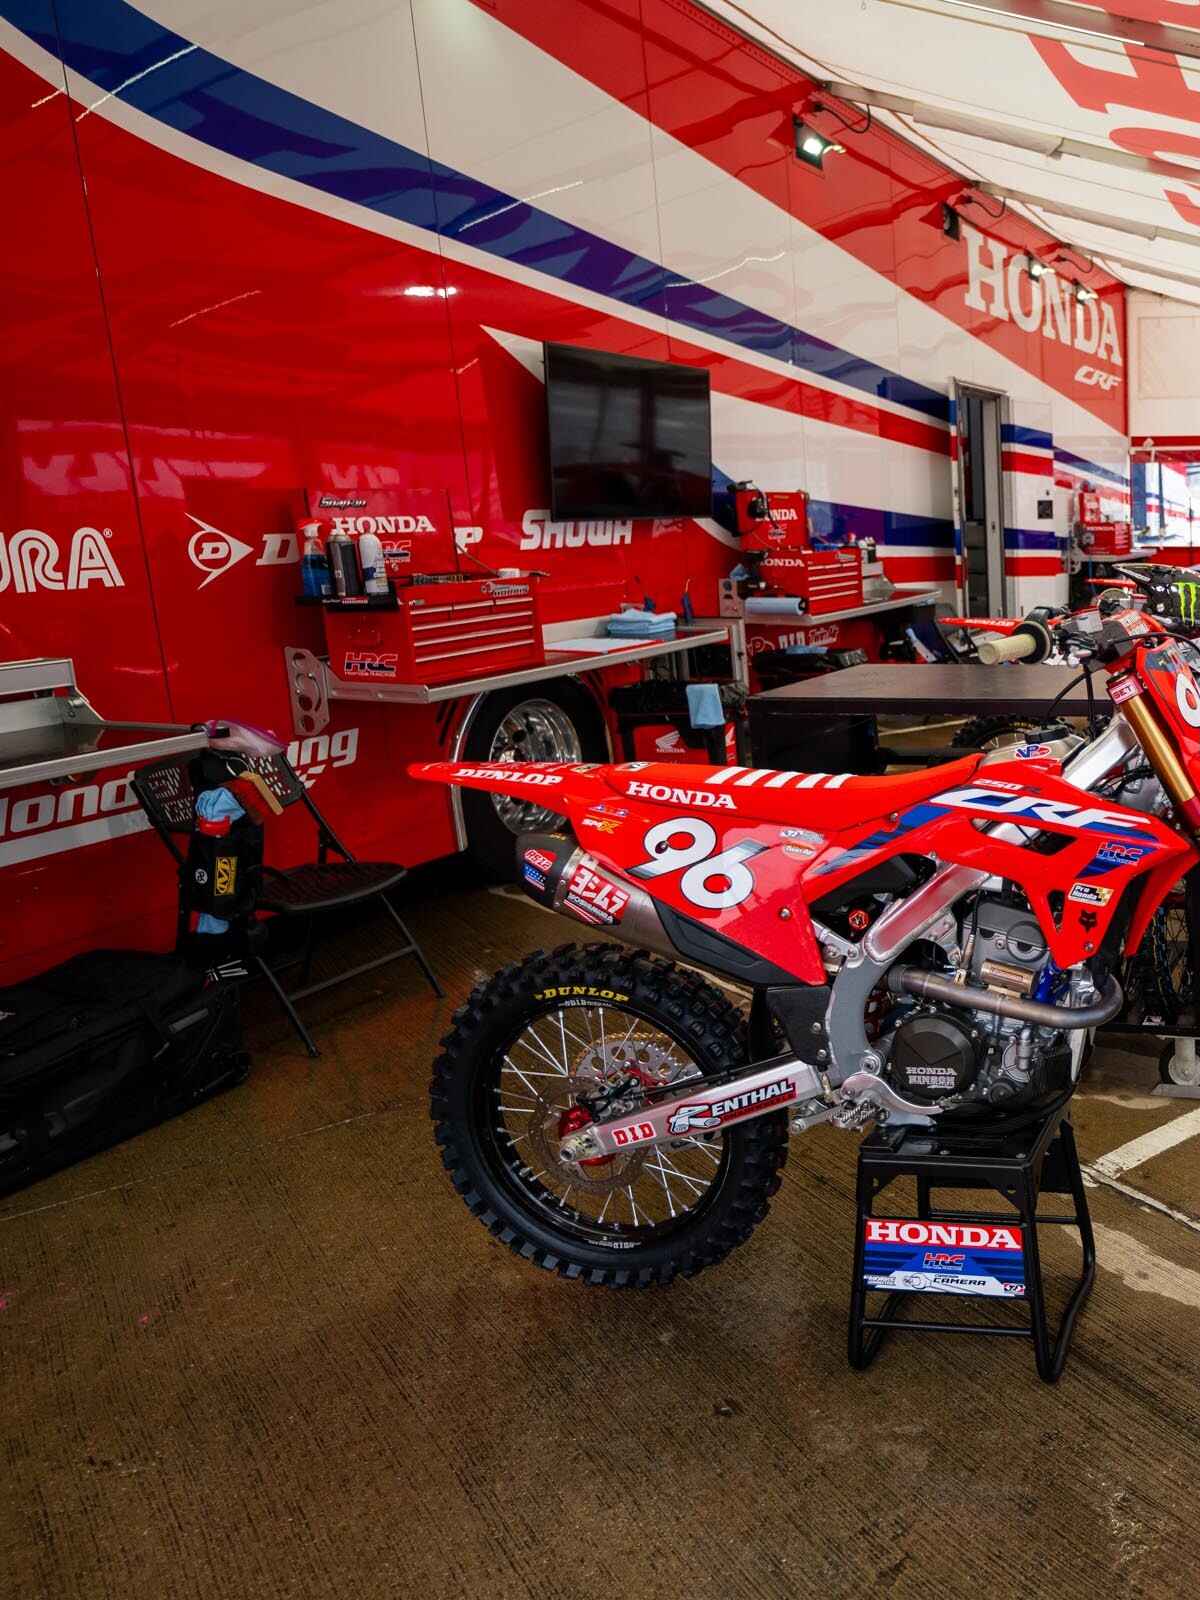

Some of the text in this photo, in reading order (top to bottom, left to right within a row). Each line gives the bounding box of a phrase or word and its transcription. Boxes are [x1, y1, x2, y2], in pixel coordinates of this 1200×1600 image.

[962, 223, 1123, 367] HONDA
[1074, 365, 1122, 391] CRF
[331, 515, 436, 535] HONDA
[345, 652, 398, 672] HRC
[451, 768, 563, 785] DUNLOP
[972, 778, 1043, 794] 250R
[626, 781, 737, 809] HONDA
[930, 788, 1151, 828] CRF
[1097, 841, 1143, 863] HRC
[625, 816, 768, 910] 96
[570, 867, 629, 914] ヨシムラ
[544, 986, 630, 1001] DUNLOP
[906, 1066, 957, 1076] HONDA
[867, 1221, 1021, 1249] HONDA
[923, 1252, 965, 1268] HRC
[932, 1278, 987, 1286] CAMERA
